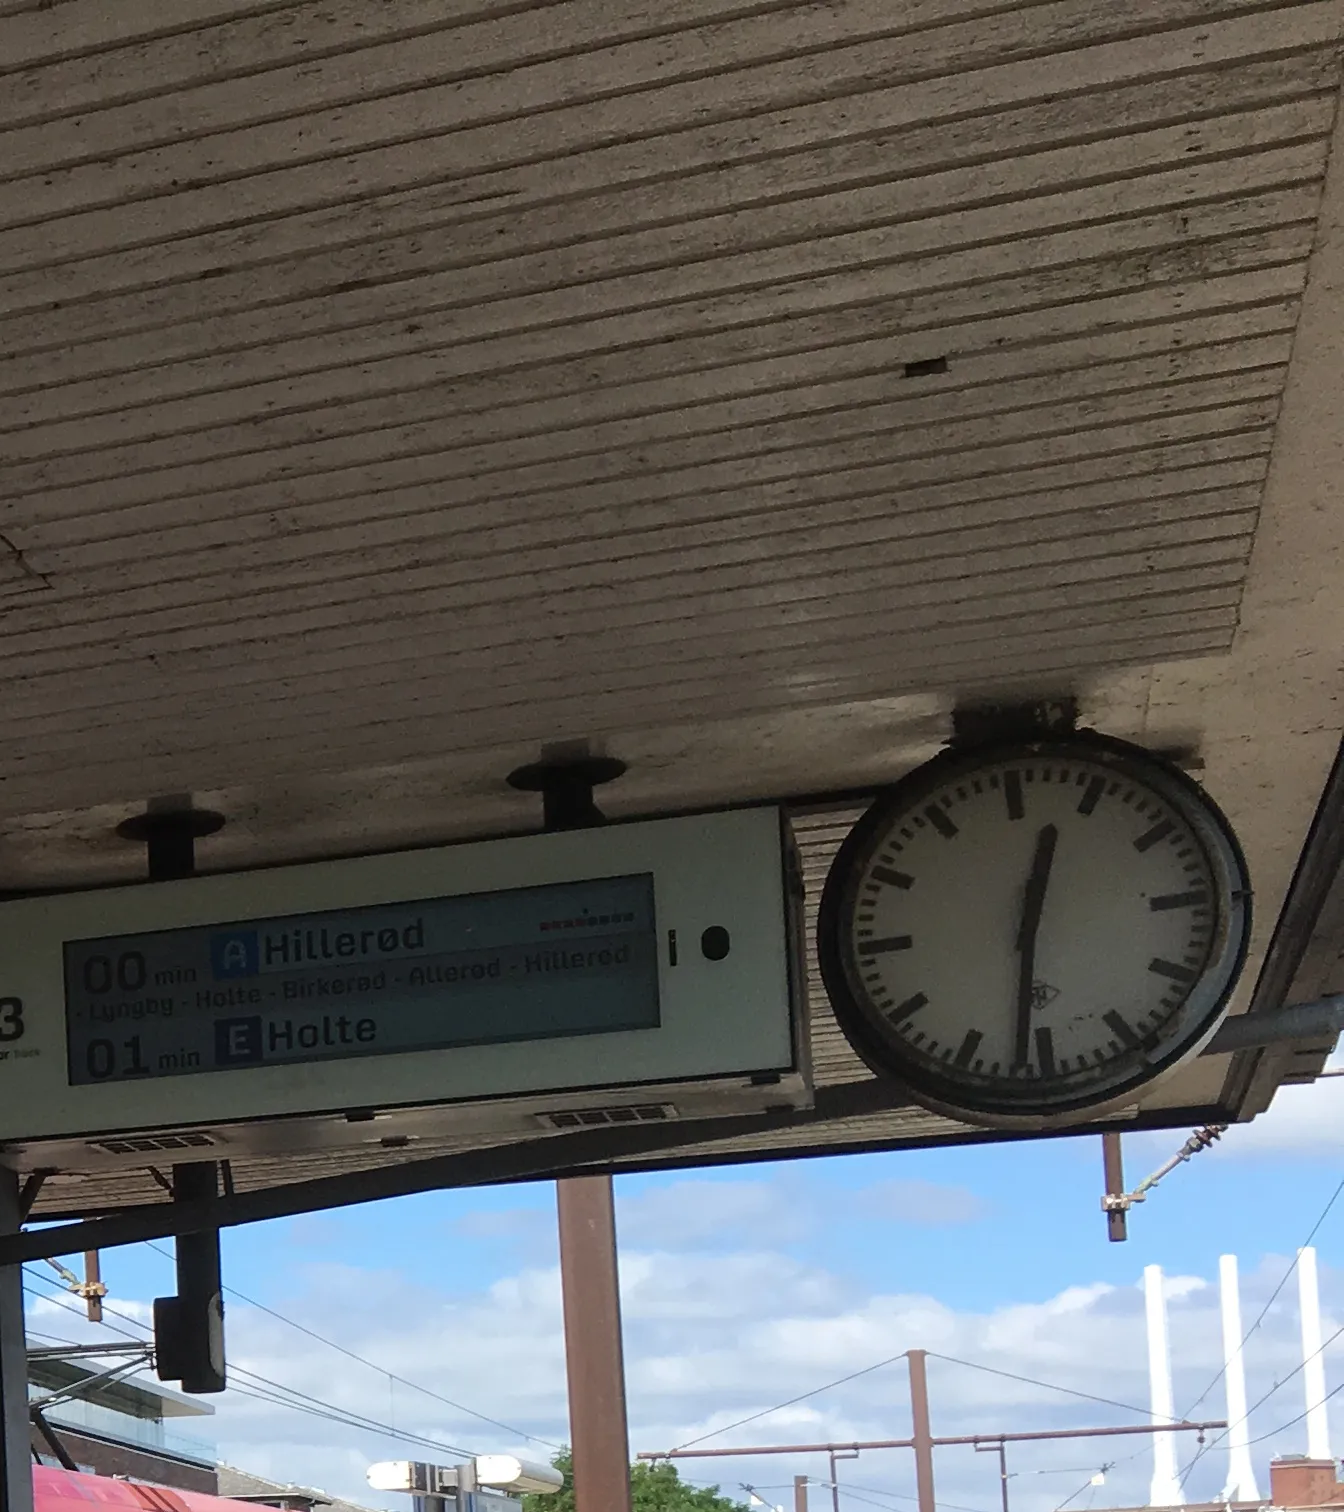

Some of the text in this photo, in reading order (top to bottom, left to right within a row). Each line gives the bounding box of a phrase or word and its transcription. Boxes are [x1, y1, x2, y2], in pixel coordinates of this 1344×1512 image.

[84, 917, 425, 995] 00 min A Hillerød
[89, 996, 174, 1023] Lyngby
[195, 985, 262, 1009] Holte
[86, 1015, 377, 1079] 01 min E Holte
